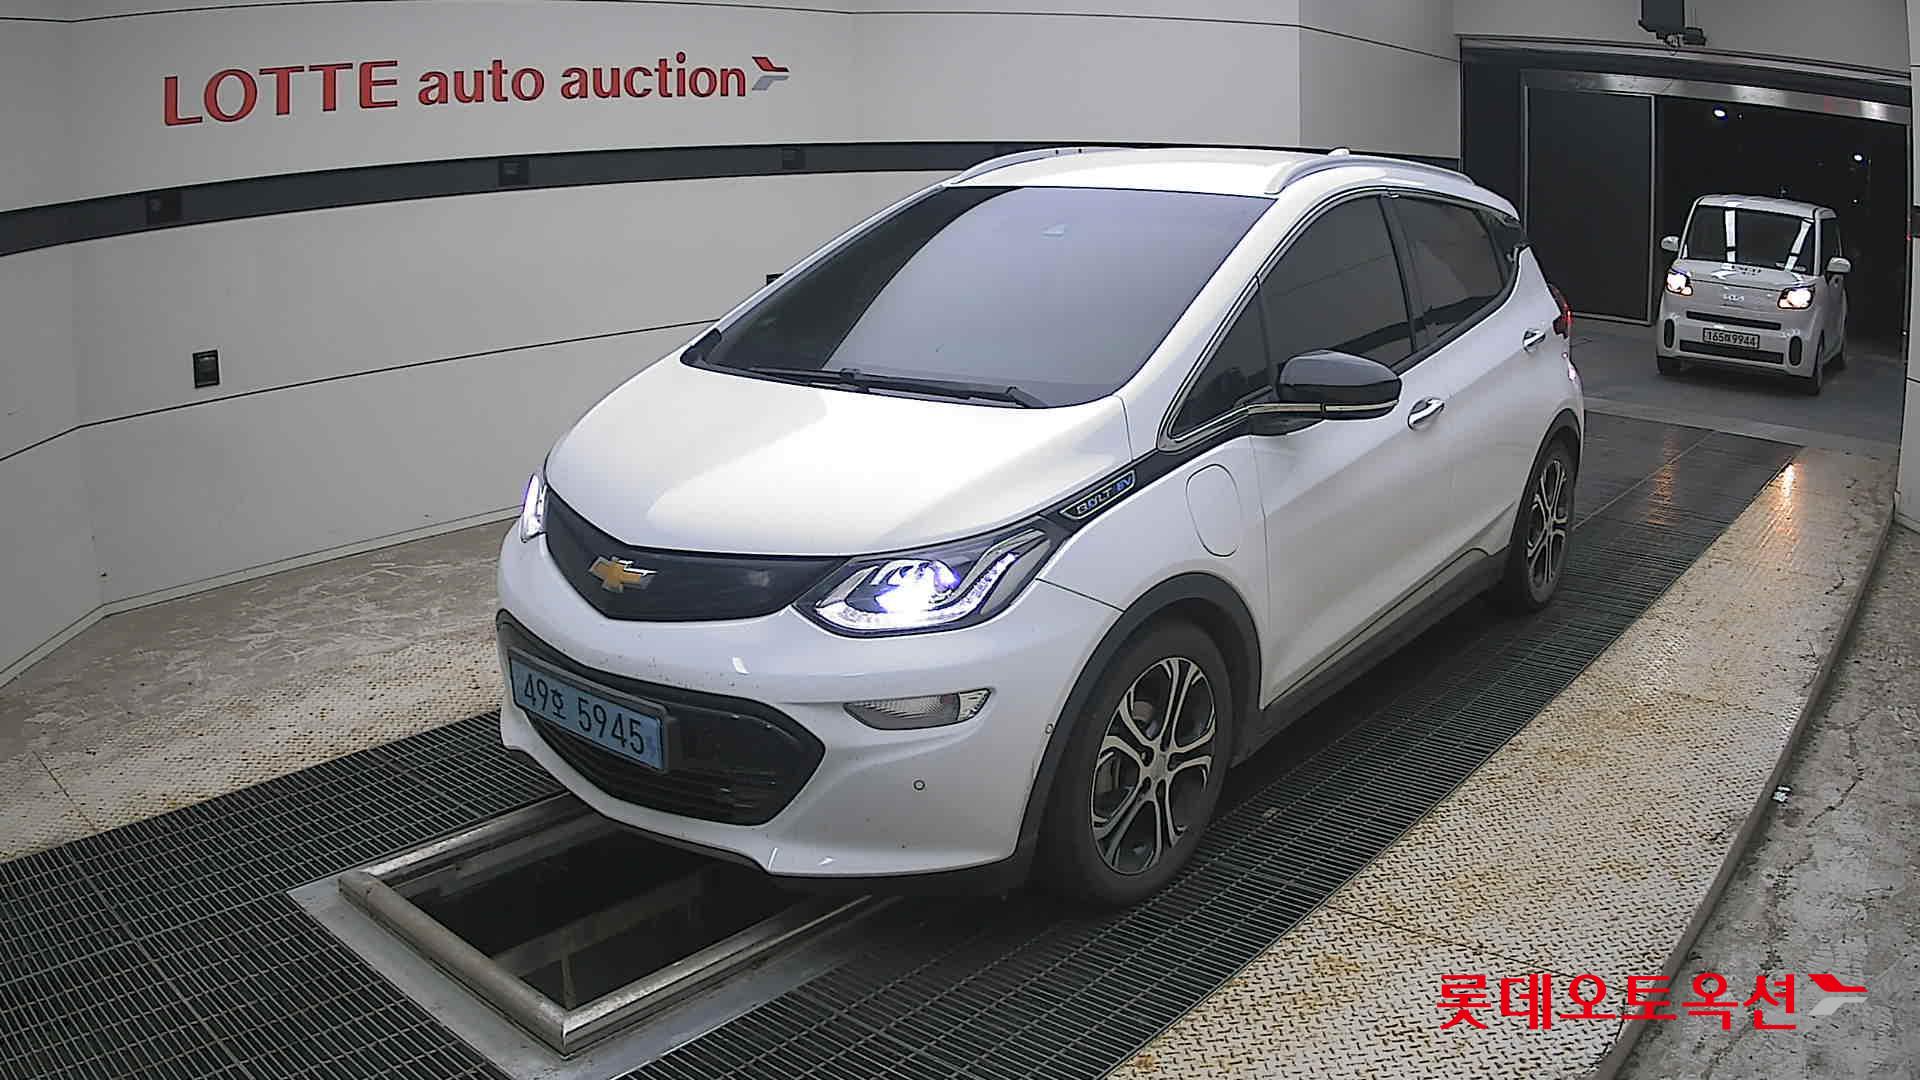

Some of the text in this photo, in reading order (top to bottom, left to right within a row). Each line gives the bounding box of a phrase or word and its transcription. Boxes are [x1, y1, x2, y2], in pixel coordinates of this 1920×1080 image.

[164, 51, 747, 126] LOTTE auto auction
[1077, 475, 1132, 514] BOLT EV
[524, 673, 645, 754] 49호 5945
